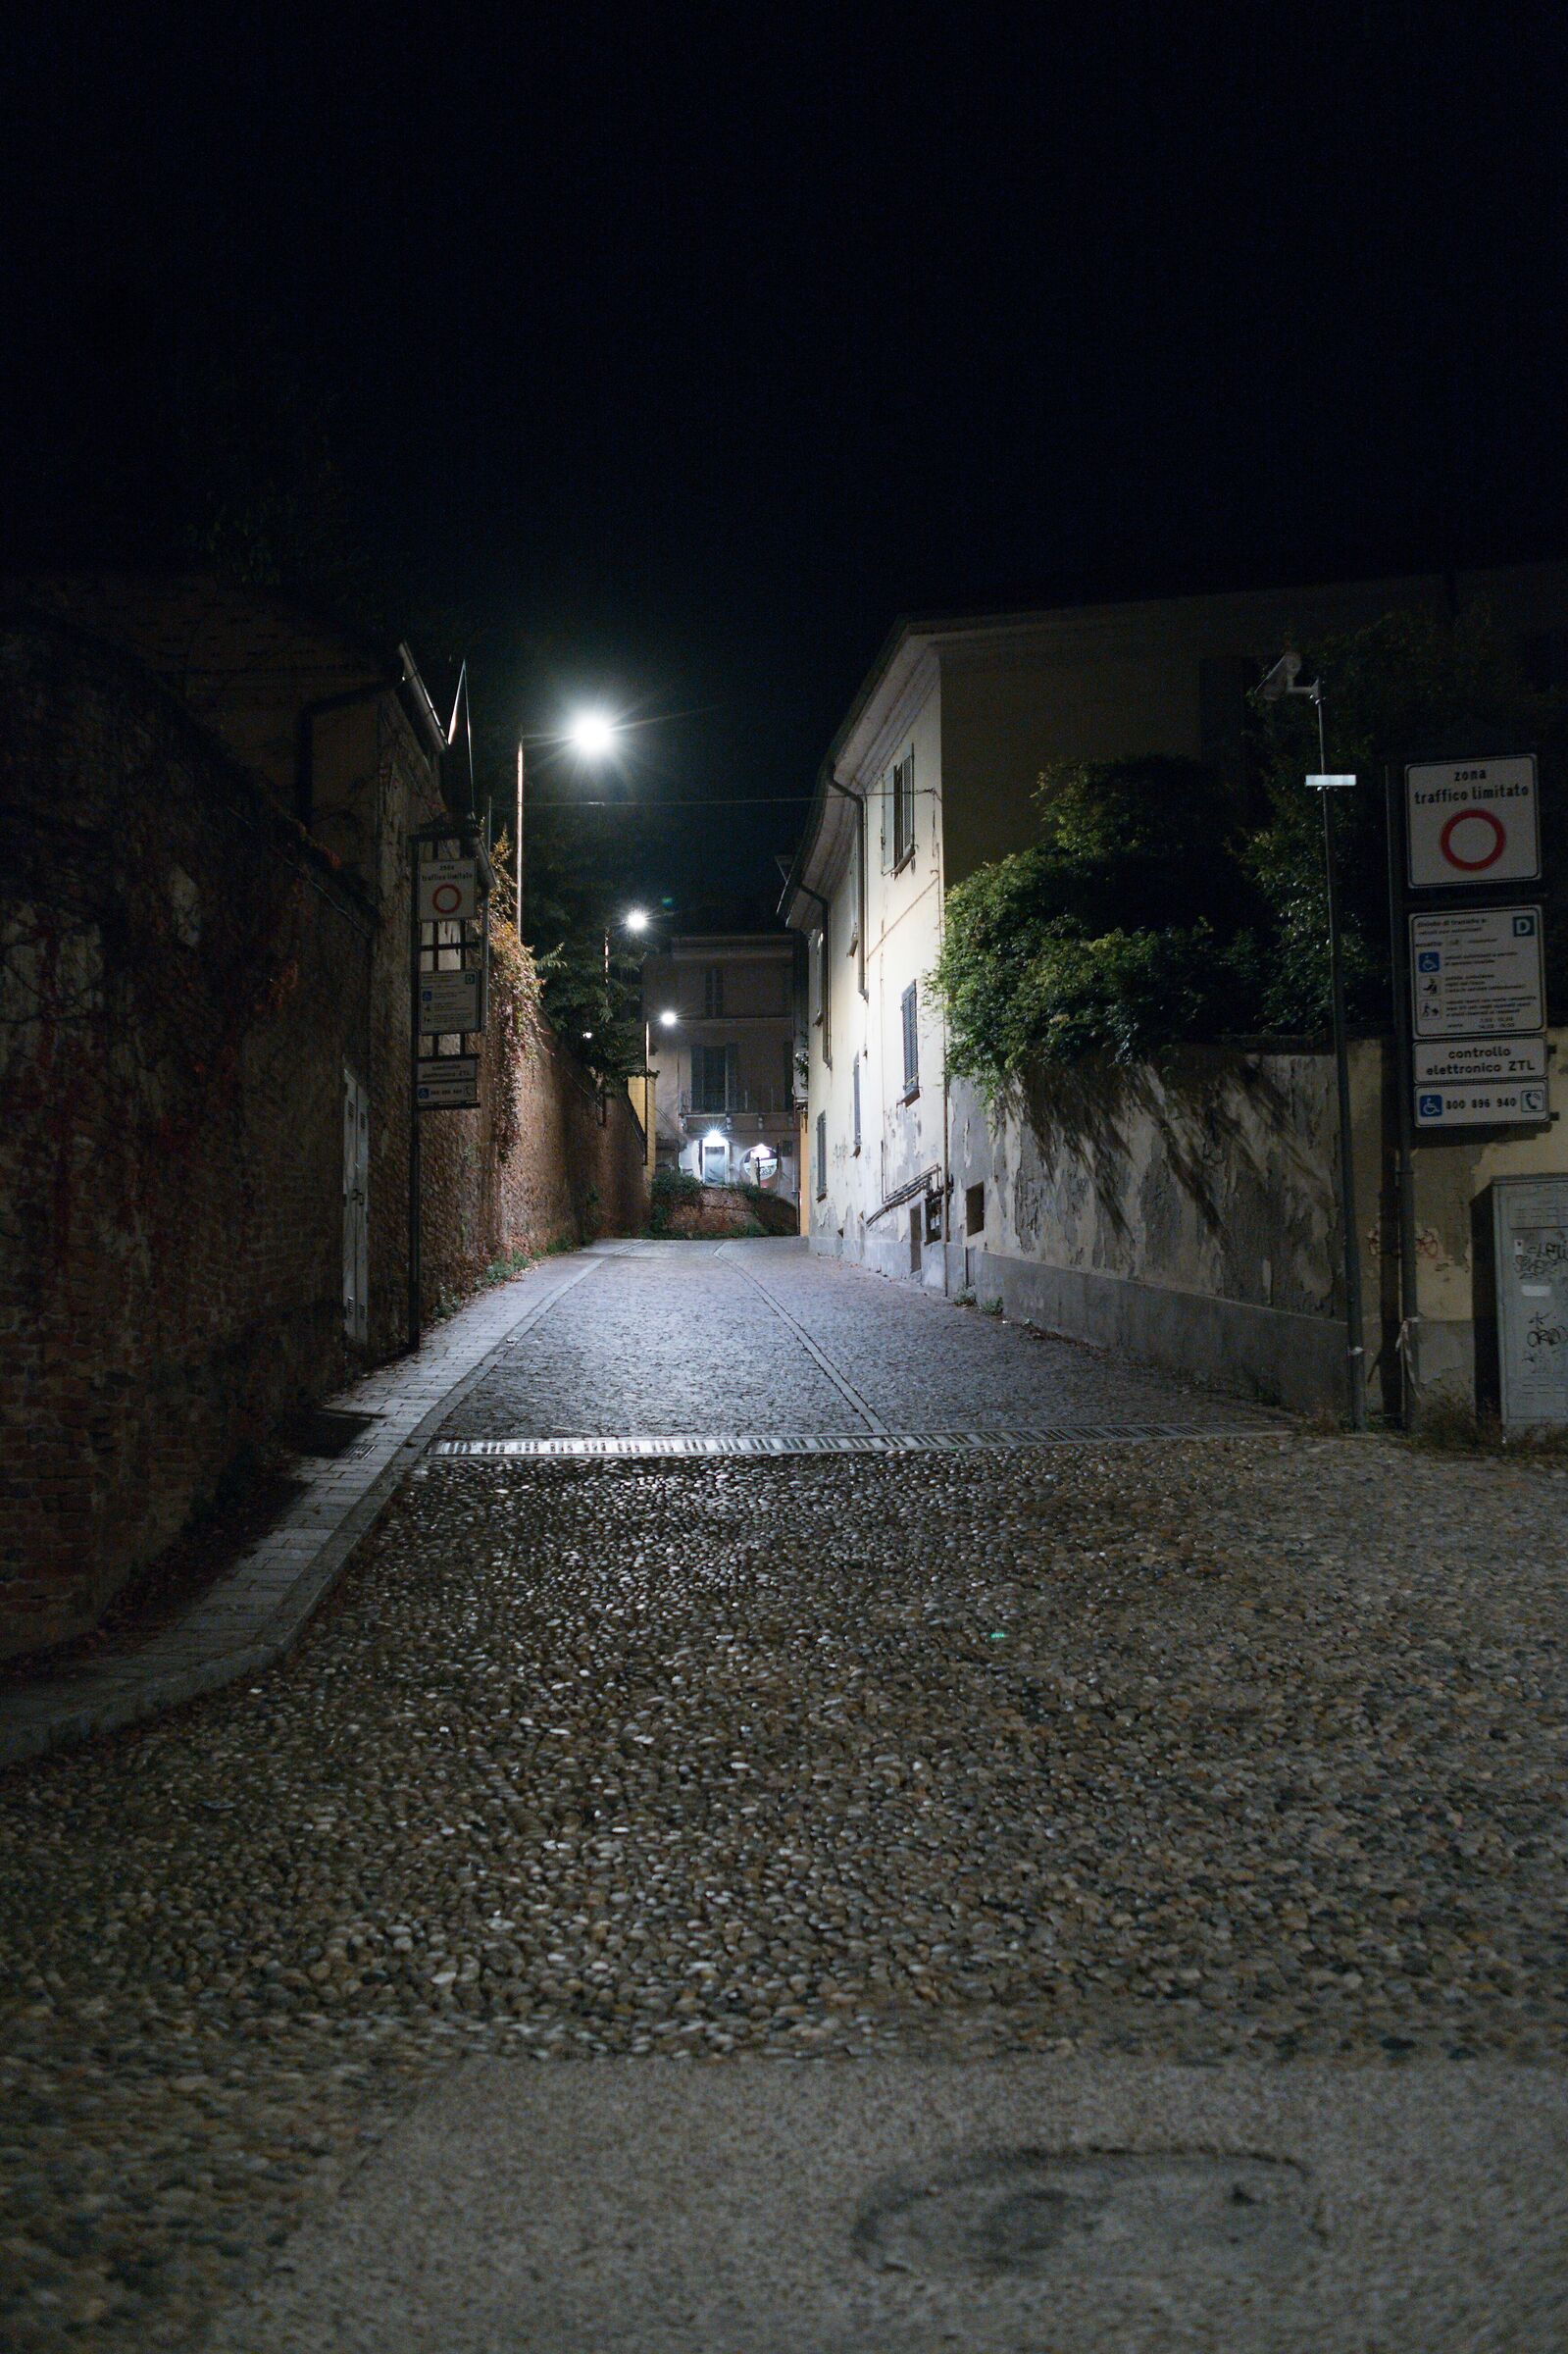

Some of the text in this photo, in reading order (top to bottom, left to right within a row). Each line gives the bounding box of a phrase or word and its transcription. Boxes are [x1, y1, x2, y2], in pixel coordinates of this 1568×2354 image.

[1454, 769, 1487, 782] zona
[1414, 784, 1529, 804] traffico limitato
[1516, 918, 1531, 933] D
[1448, 1046, 1511, 1059] controllo
[1426, 1060, 1536, 1076] elettronico ZTL
[1445, 1100, 1466, 1110] 800
